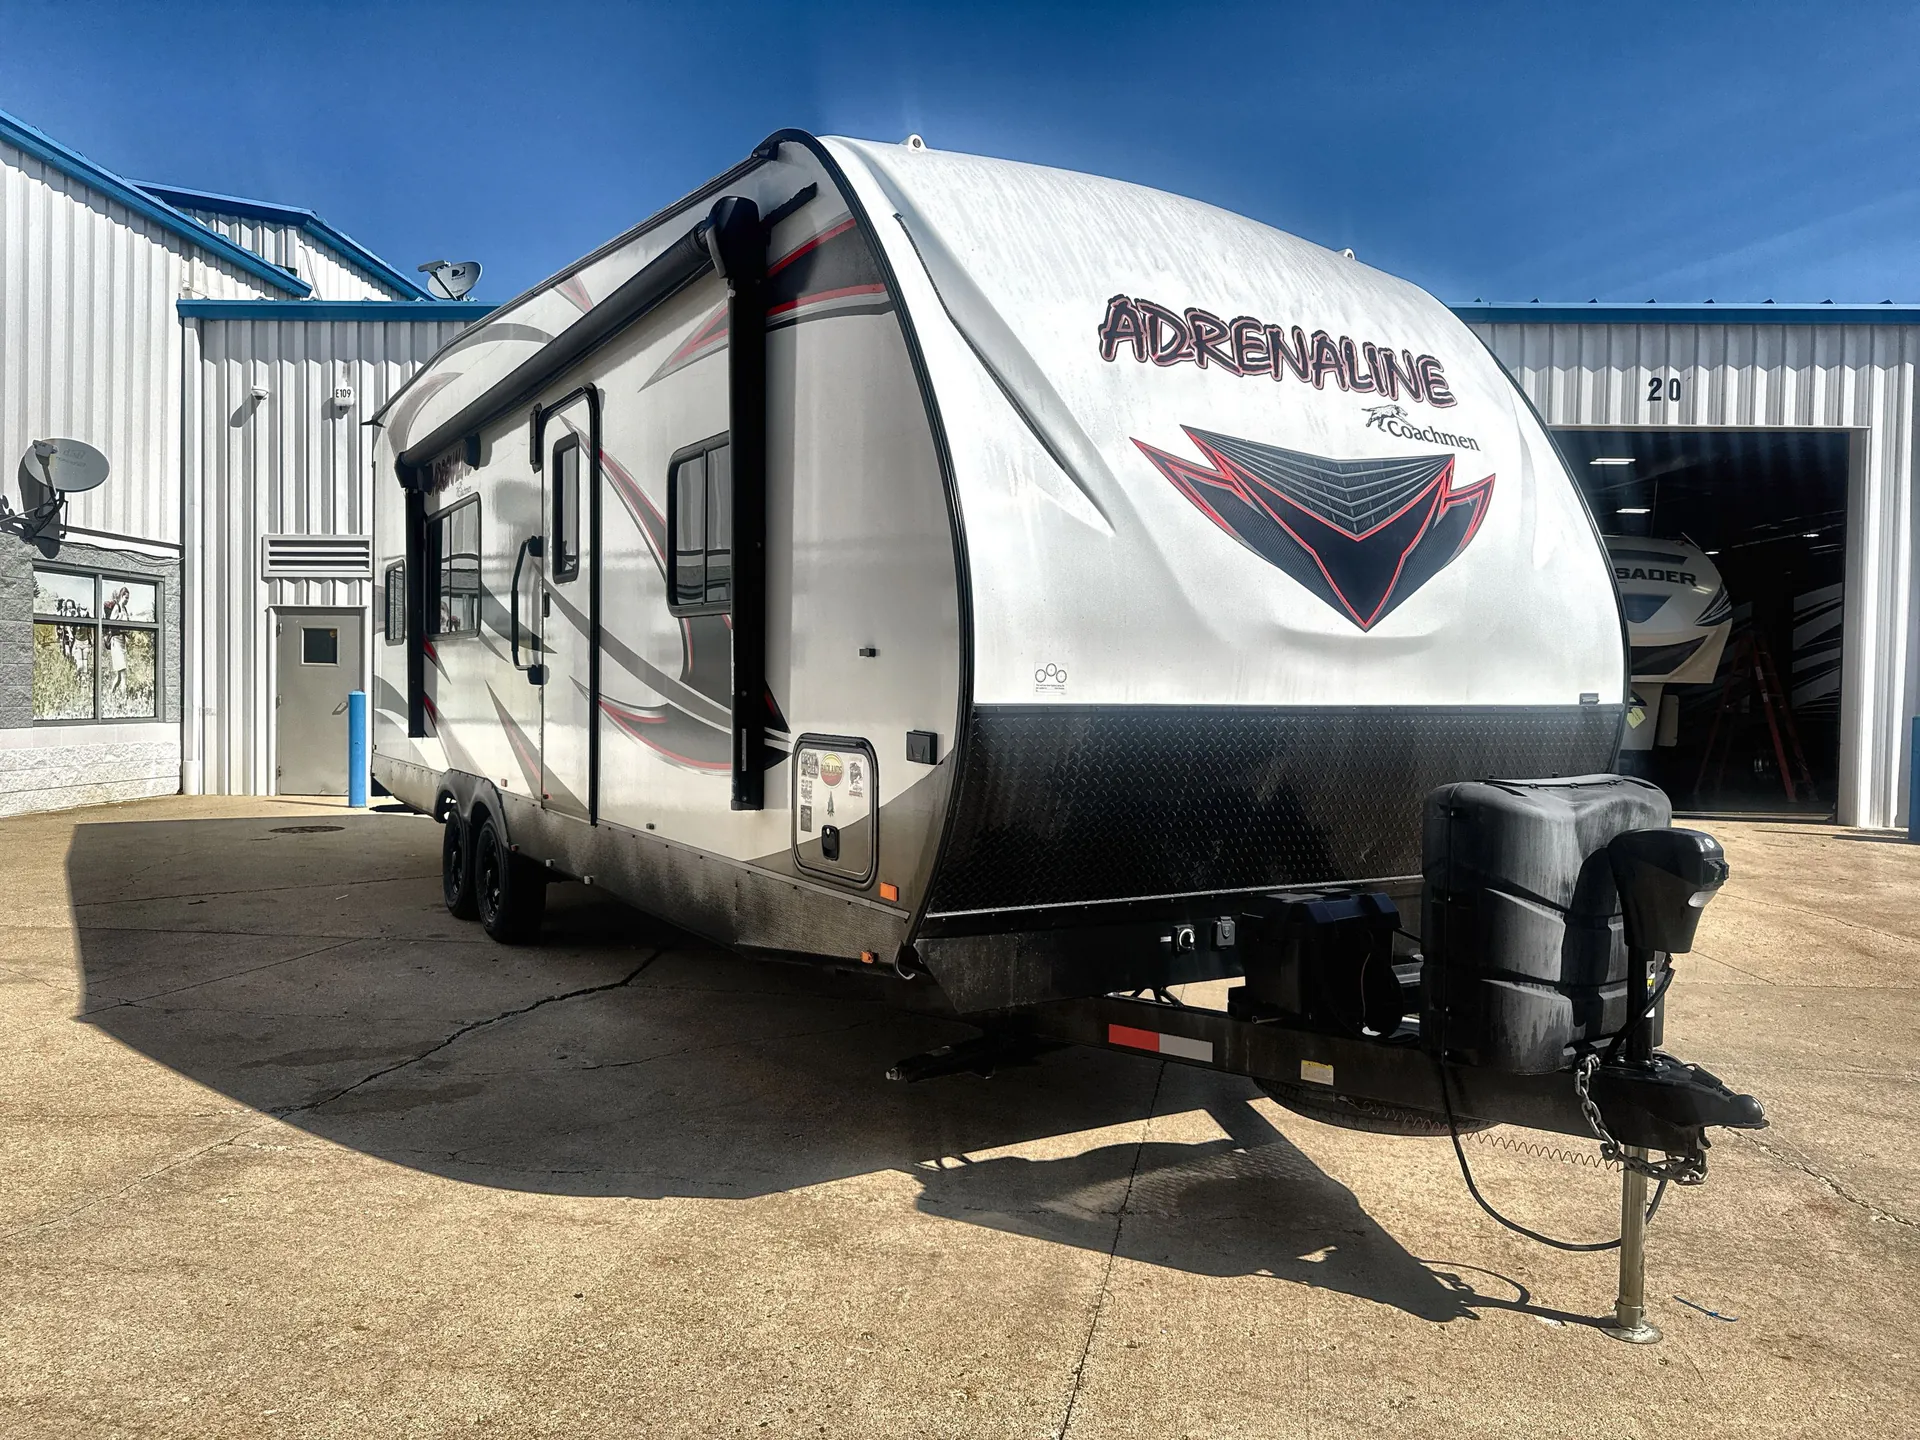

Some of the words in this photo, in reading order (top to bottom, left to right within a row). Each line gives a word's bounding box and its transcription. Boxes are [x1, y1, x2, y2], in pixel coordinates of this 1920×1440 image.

[1099, 294, 1457, 407] ADRENALINE
[335, 388, 351, 398] E109
[1647, 377, 1681, 401] 20
[1387, 420, 1481, 451] Coachmen
